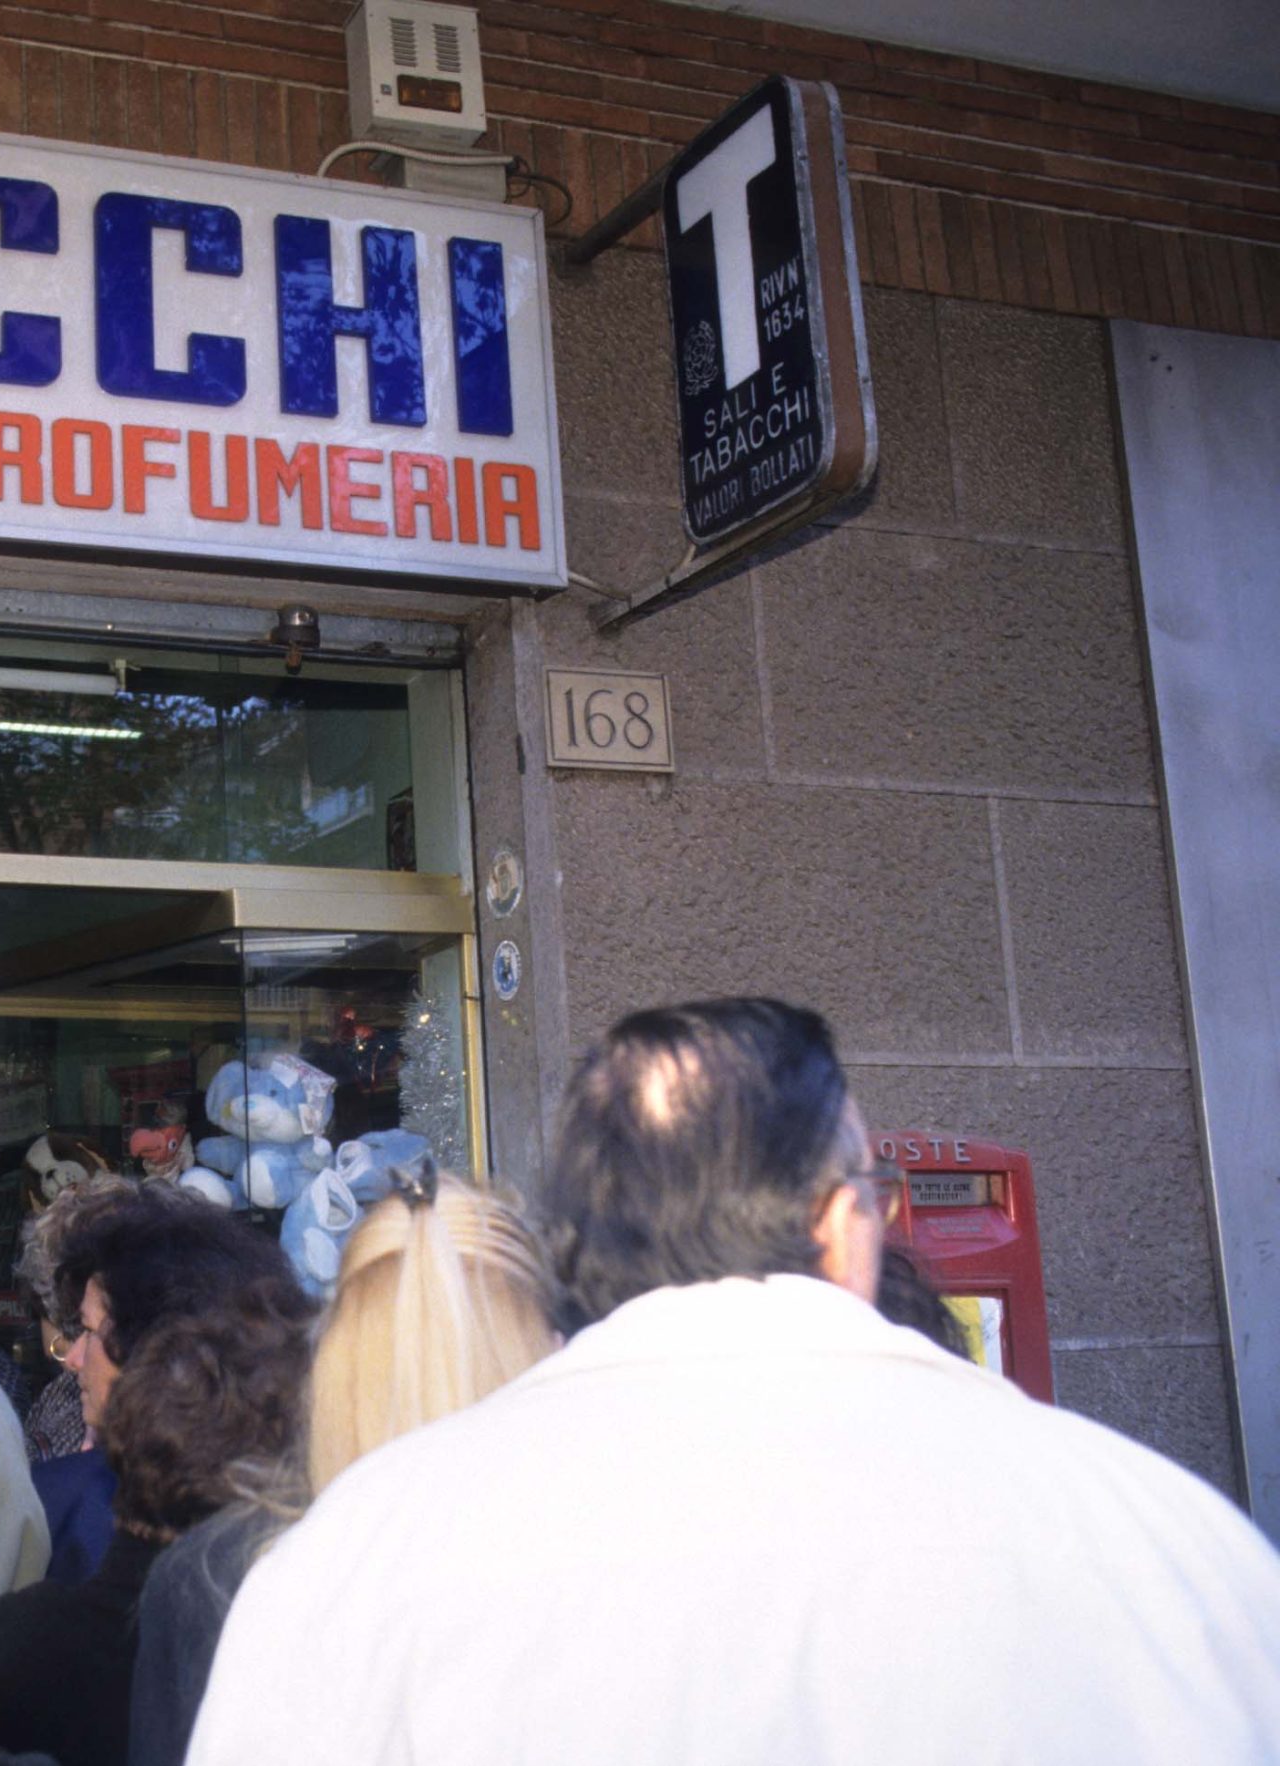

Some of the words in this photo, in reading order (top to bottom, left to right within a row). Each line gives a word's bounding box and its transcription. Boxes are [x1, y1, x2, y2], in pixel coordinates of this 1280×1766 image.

[677, 103, 776, 391] T
[764, 293, 804, 342] 1634
[689, 386, 810, 484] TABACCHI
[704, 381, 757, 438] SALI
[771, 362, 786, 396] E
[693, 476, 744, 528] VALORI
[750, 433, 814, 496] BOLLATI
[564, 687, 654, 749] 168
[880, 1139, 972, 1162] OSTE
